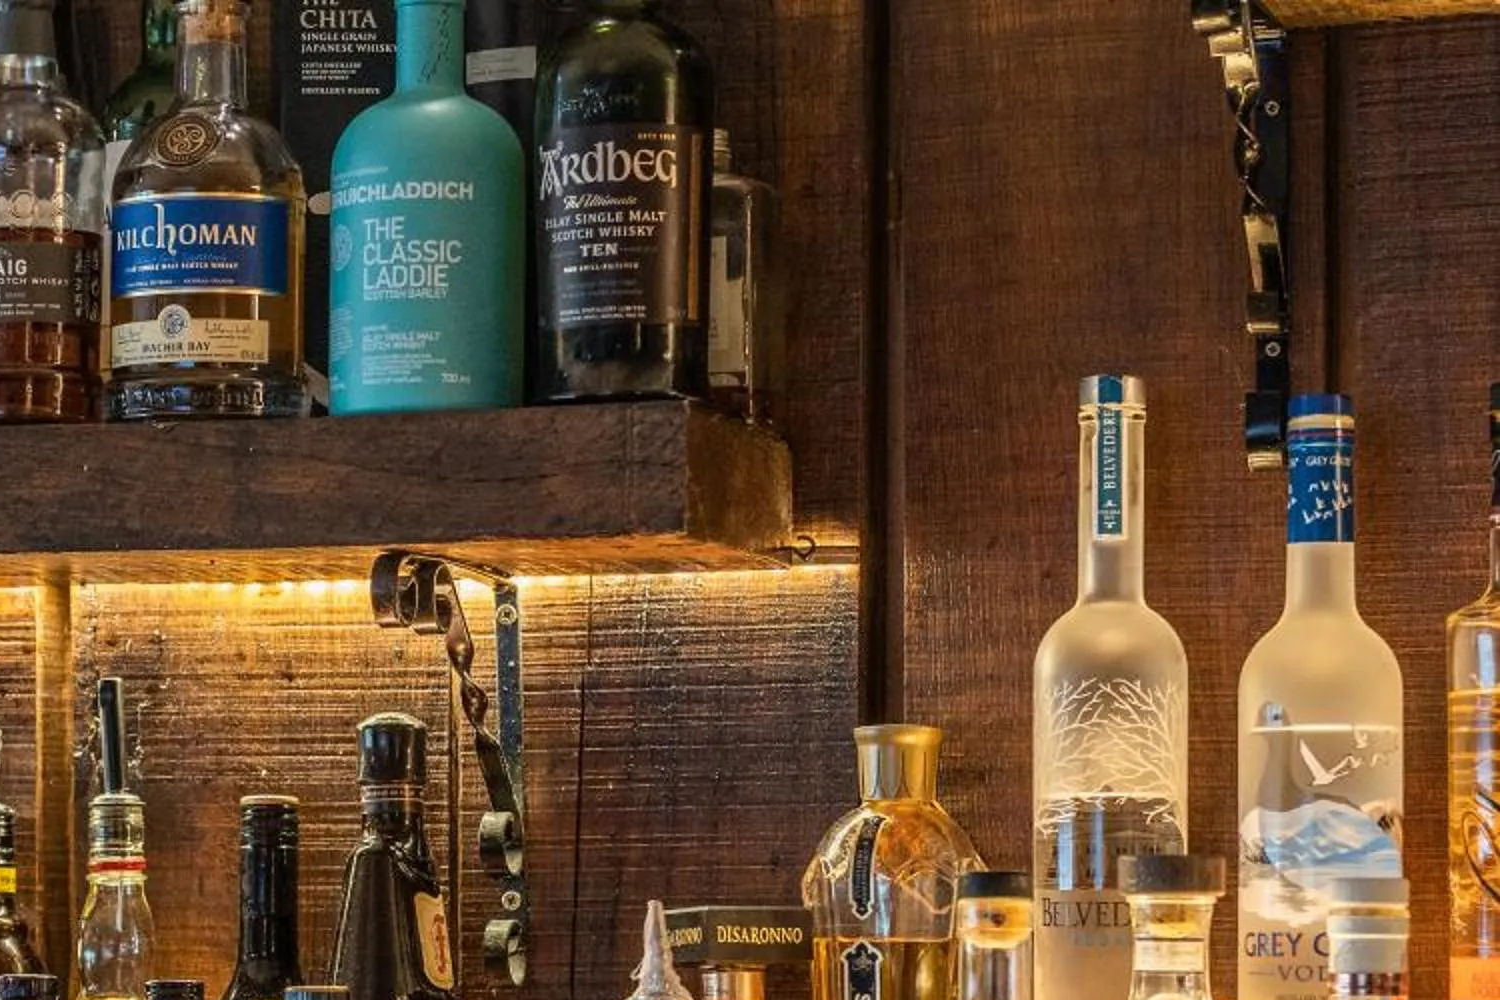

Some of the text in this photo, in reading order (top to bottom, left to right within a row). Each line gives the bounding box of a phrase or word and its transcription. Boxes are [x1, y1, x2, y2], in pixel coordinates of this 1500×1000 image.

[300, 8, 378, 29] CHITA
[301, 32, 377, 41] SINGLE GRAIN
[301, 43, 354, 54] JAPANESE
[574, 211, 625, 226] SINGLE
[629, 209, 668, 222] MALT
[363, 215, 405, 241] THE
[552, 225, 656, 243] SCOTCH WHISKY
[363, 239, 462, 265] CLASSIC
[579, 242, 619, 257] TEN
[363, 263, 449, 289] LADDIE
[187, 341, 211, 353] BAY
[1103, 408, 1117, 489] BELVEDERE
[1043, 897, 1132, 928] BELVED
[716, 925, 803, 945] DISARONNO
[1244, 931, 1303, 957] GREY
